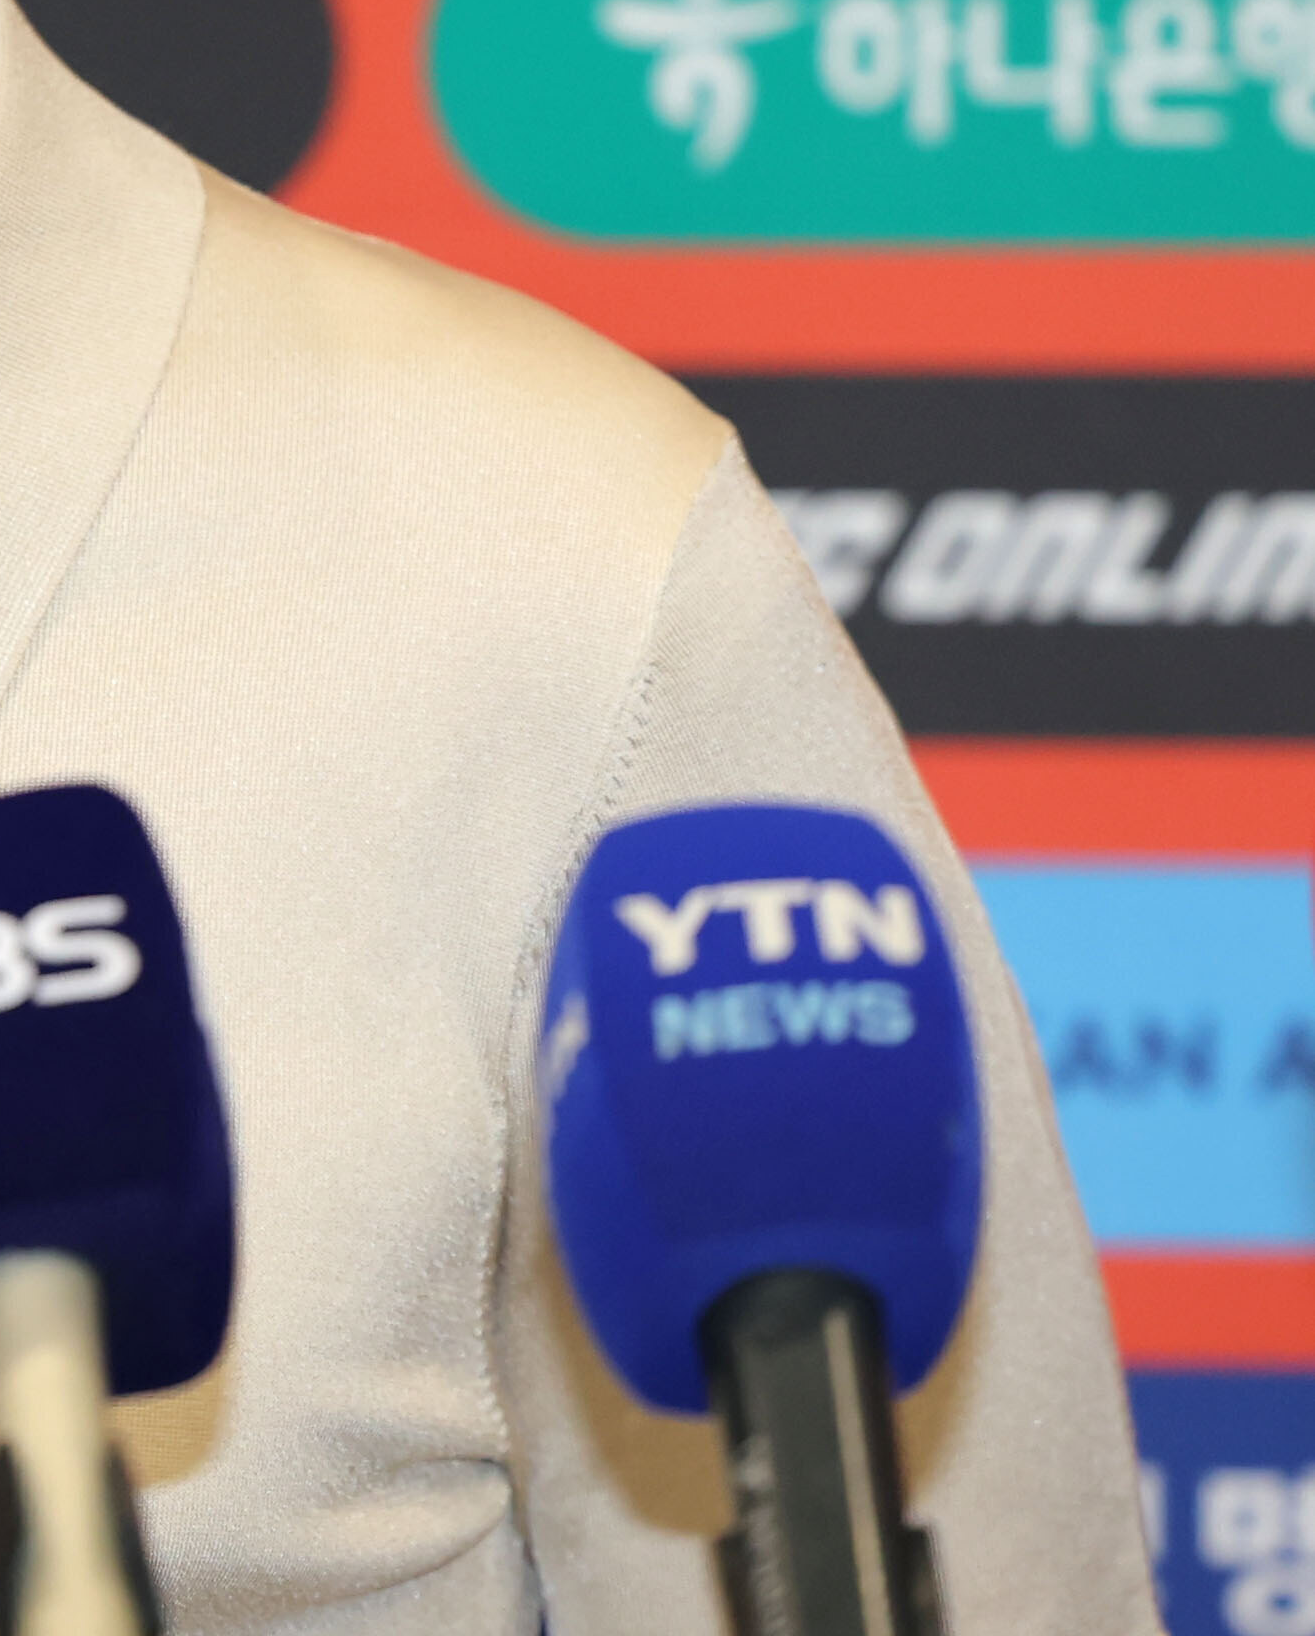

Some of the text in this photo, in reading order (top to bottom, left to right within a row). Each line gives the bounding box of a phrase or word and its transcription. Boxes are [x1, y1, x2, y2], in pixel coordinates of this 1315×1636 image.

[613, 877, 926, 977] YTN
[650, 978, 916, 1062] NEWS
[1137, 1460, 1315, 1636] 명
